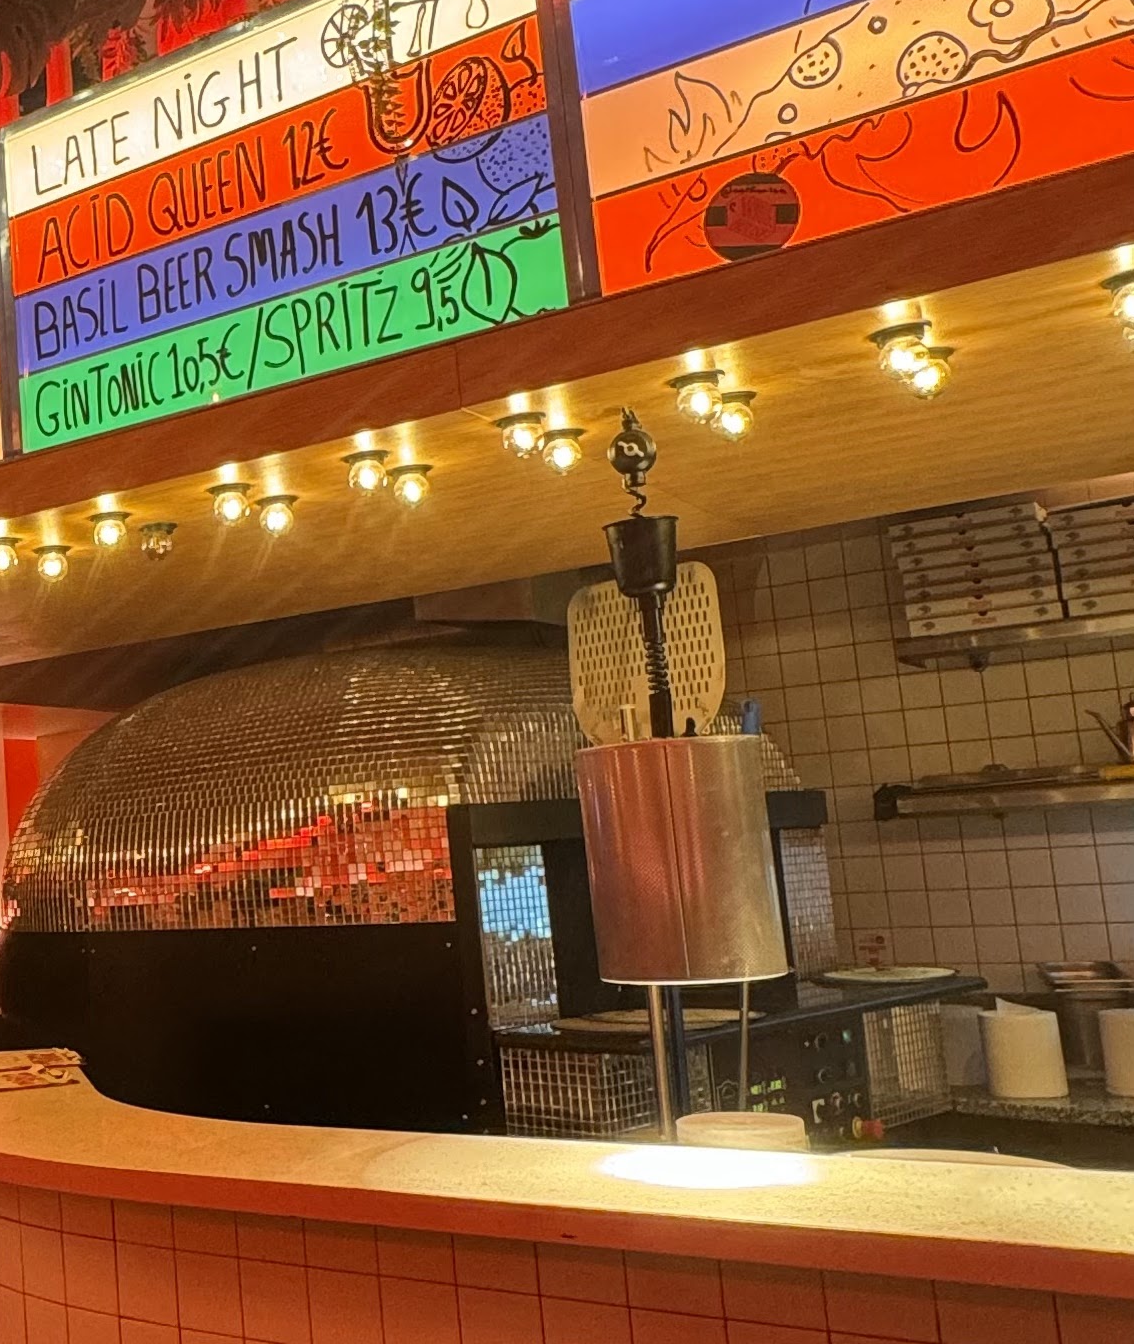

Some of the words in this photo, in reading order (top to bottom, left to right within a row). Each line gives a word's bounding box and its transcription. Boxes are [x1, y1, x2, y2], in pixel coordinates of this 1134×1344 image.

[30, 110, 131, 196] LATE
[153, 35, 298, 152] NIGHT
[36, 192, 134, 284] ACID
[147, 137, 268, 236] QUEEN
[283, 108, 350, 191] 12€
[33, 279, 128, 362] BASIL
[136, 247, 218, 331] BEER
[226, 203, 343, 297] SMASH
[355, 172, 438, 256] 13€
